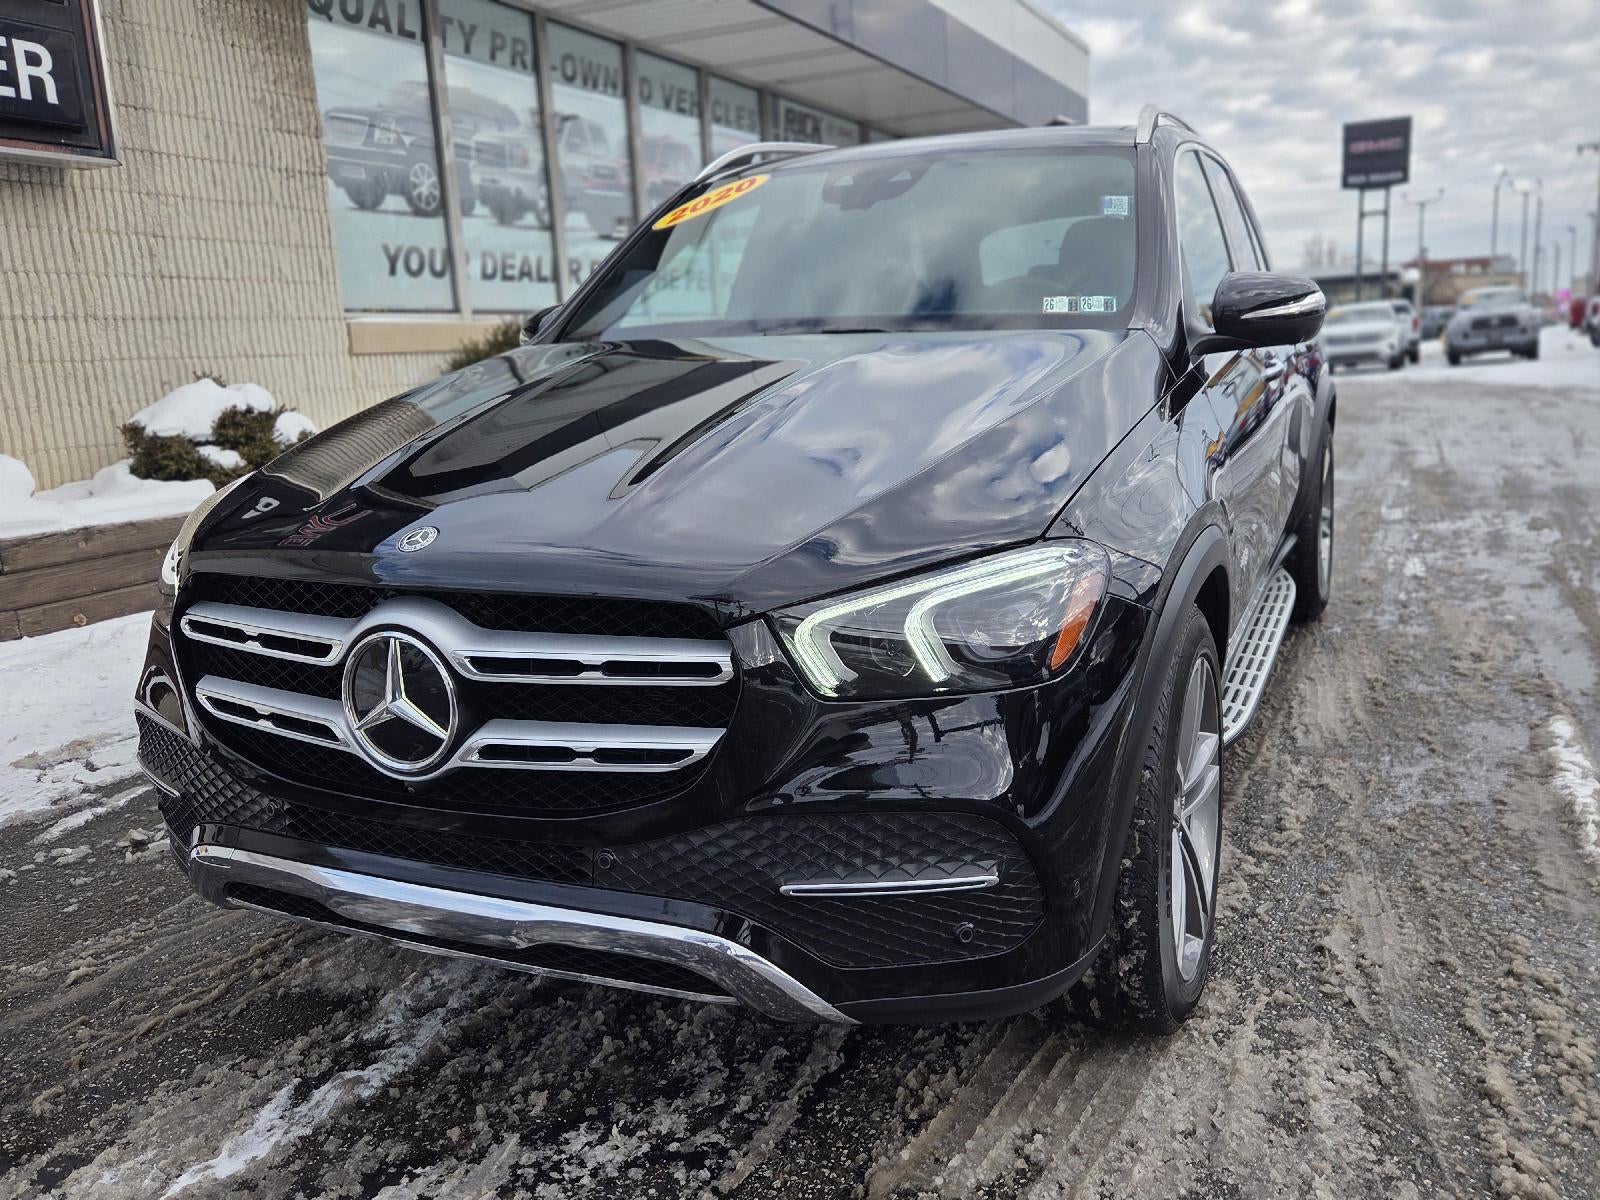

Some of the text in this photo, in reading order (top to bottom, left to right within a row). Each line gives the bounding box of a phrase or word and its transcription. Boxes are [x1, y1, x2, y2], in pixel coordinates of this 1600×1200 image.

[309, 0, 757, 131] QUALTY PR-OWND VEHCLES
[666, 178, 757, 225] 2020
[382, 244, 469, 281] YOU
[481, 250, 582, 284] DEALR
[1044, 299, 1054, 310] 26
[1082, 298, 1092, 310] 26
